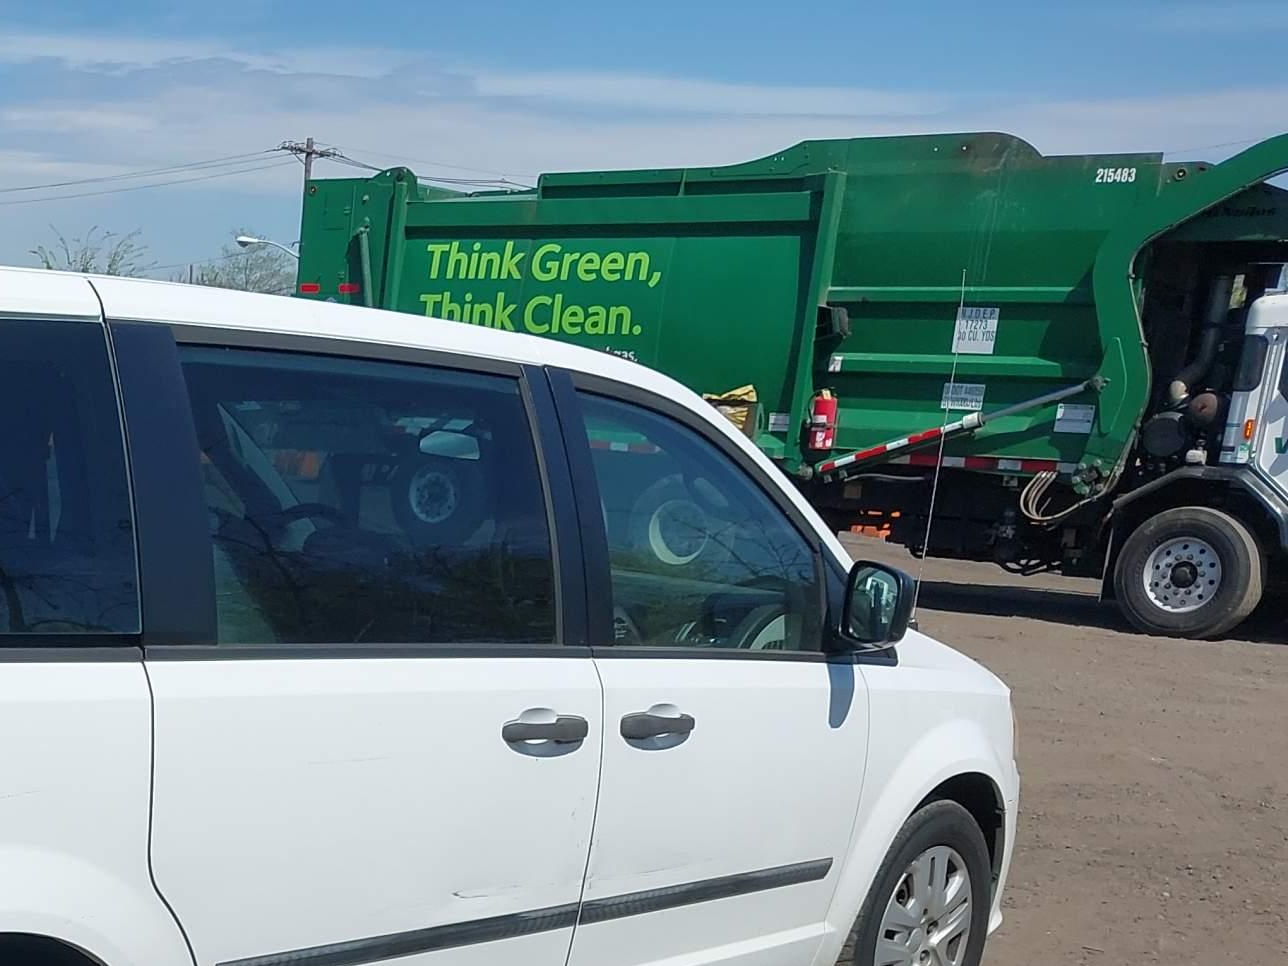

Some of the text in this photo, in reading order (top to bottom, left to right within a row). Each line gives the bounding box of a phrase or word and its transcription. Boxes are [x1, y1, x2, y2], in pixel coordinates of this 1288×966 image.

[1095, 167, 1137, 183] 215483
[427, 240, 662, 288] Think Green,
[419, 291, 643, 335] Think Clean.
